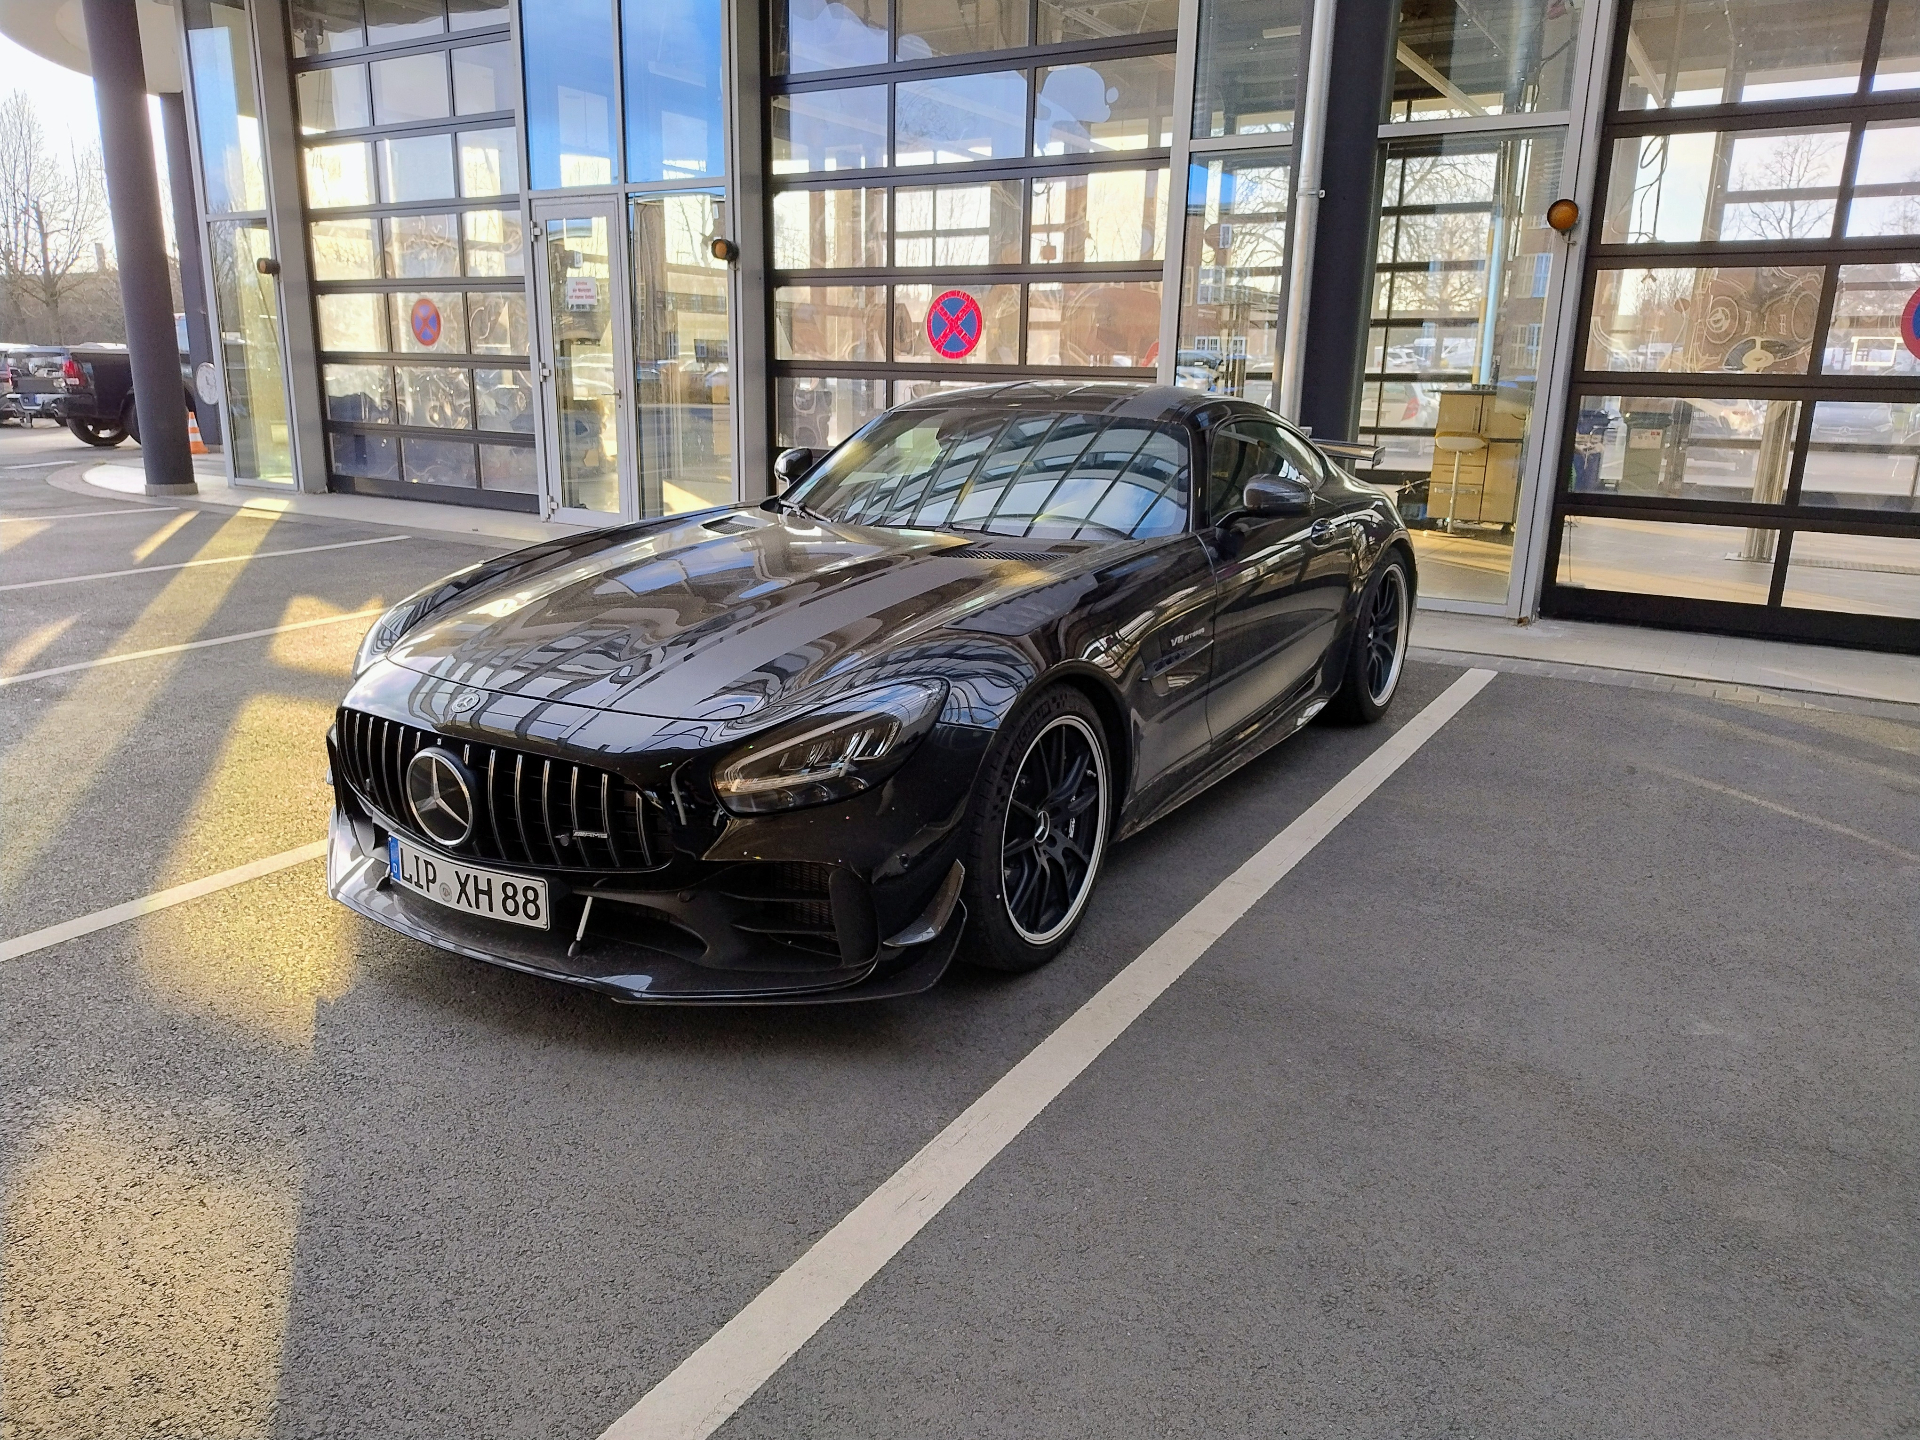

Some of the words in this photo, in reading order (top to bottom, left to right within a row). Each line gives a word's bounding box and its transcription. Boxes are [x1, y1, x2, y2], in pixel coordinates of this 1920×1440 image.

[1170, 634, 1185, 647] V8
[400, 847, 437, 893] LIP
[454, 870, 493, 912] XH
[501, 882, 541, 920] 88
